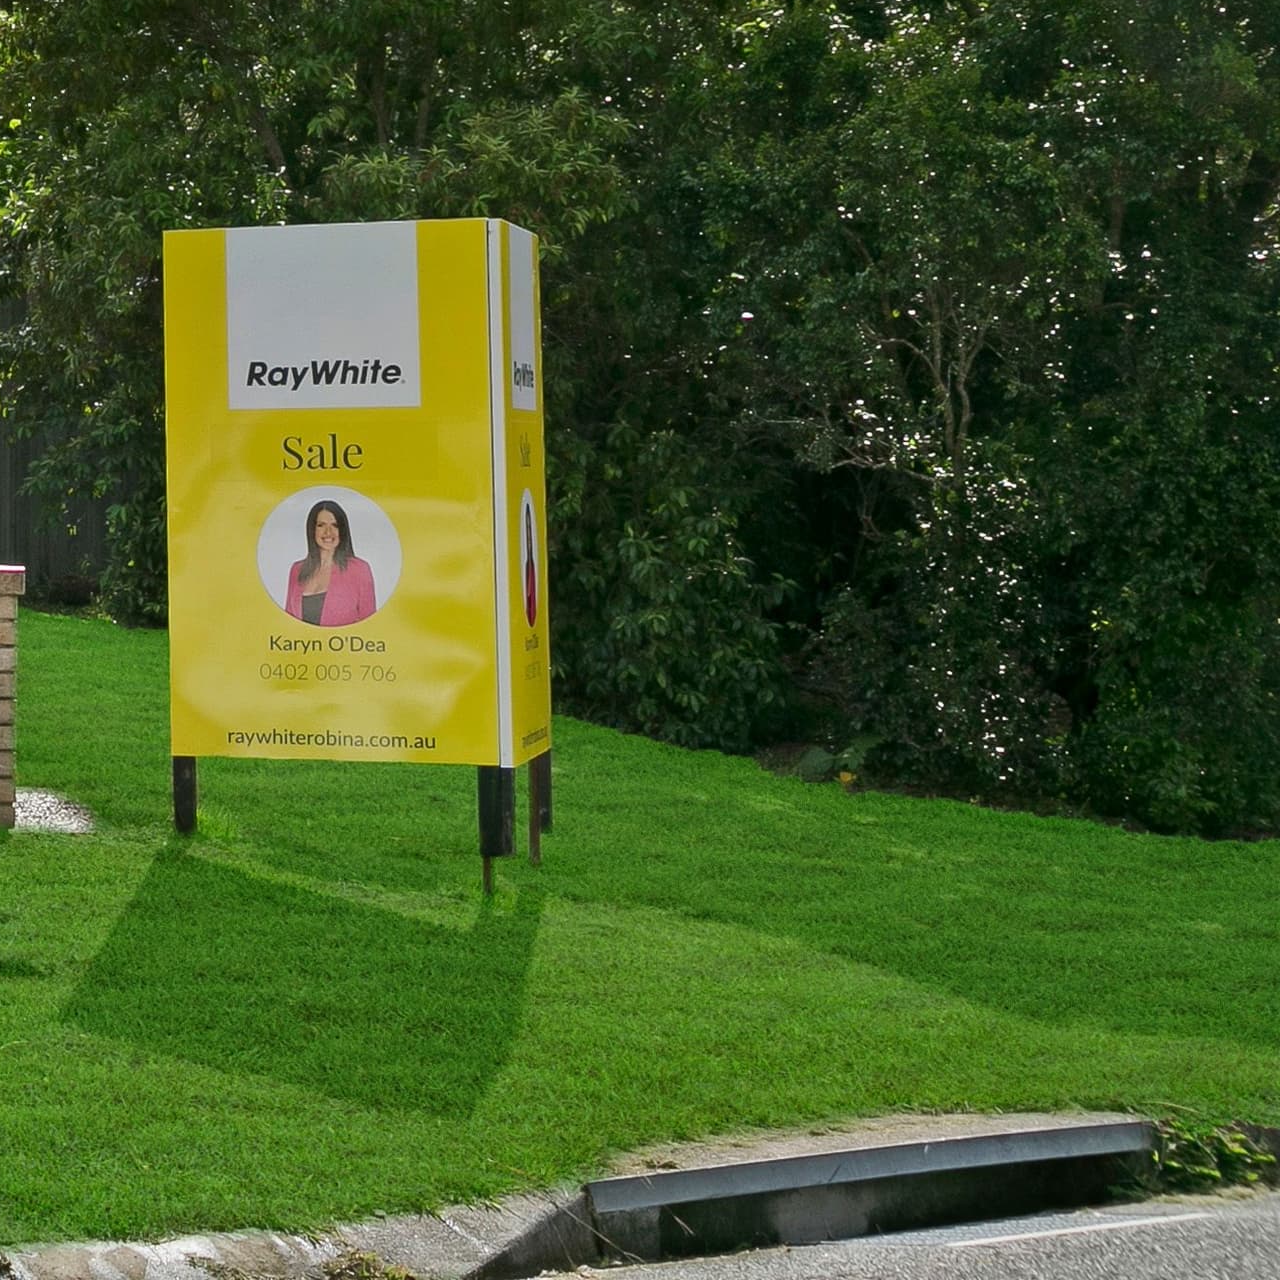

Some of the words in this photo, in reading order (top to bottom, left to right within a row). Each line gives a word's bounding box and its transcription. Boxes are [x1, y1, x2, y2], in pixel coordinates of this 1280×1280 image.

[282, 433, 364, 470] Sale
[269, 635, 322, 654] Karyn
[328, 635, 386, 652] O'Dea
[259, 663, 308, 680] 0402
[315, 664, 352, 681] 005
[360, 665, 397, 682] 706
[227, 728, 436, 749] raywhiterobina.com.au
